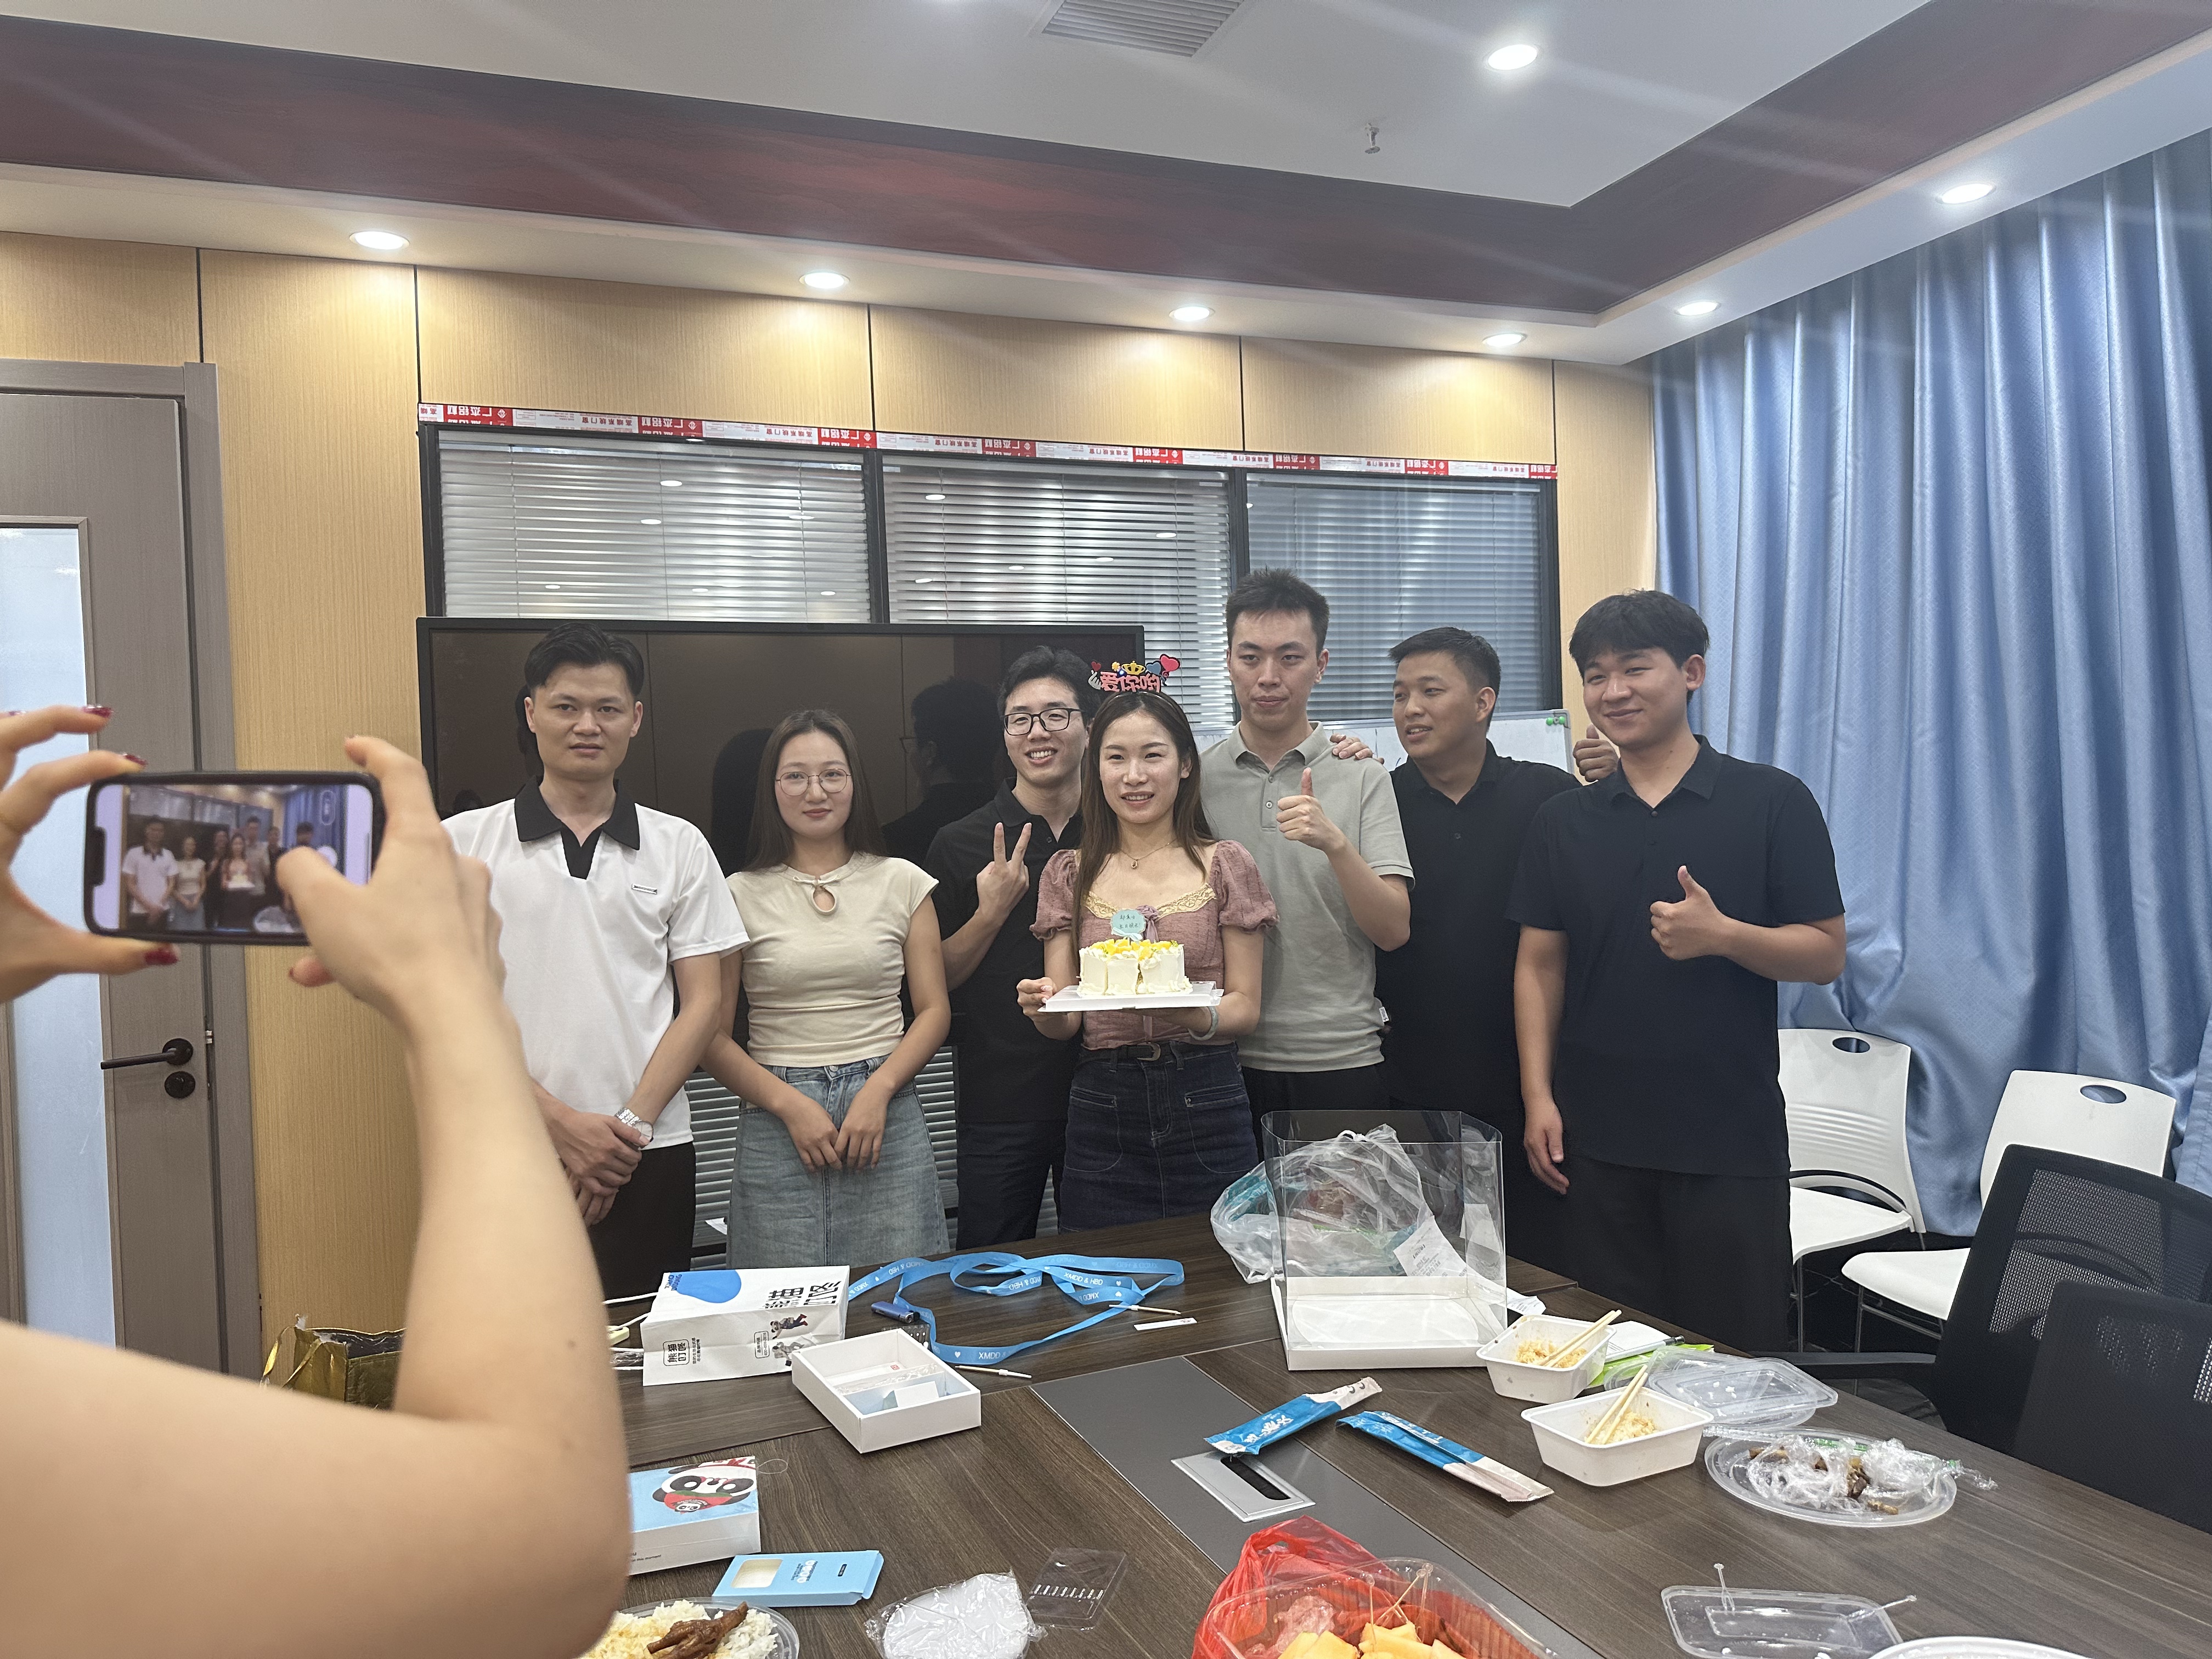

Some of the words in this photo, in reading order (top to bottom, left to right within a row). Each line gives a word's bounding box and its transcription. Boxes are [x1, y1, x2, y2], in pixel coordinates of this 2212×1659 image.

[447, 405, 492, 417] 广杰铝材
[582, 416, 633, 426] 高端系统门窗
[642, 417, 684, 428] 广杰铝材
[766, 428, 812, 437] 高端系统门窗
[821, 428, 859, 440] 广杰铝材
[935, 439, 977, 448] 高端系统门窗
[1090, 447, 1128, 456] 高端系统门窗
[1063, 1272, 1084, 1283] XMDD
[1090, 1278, 1104, 1286] HBD
[1008, 1281, 1023, 1290] HBD
[1082, 1291, 1099, 1301] XMDD
[667, 1343, 678, 1363] 熊猫
[678, 1342, 687, 1362] 叮咚
[979, 1351, 1001, 1360] XMDD
